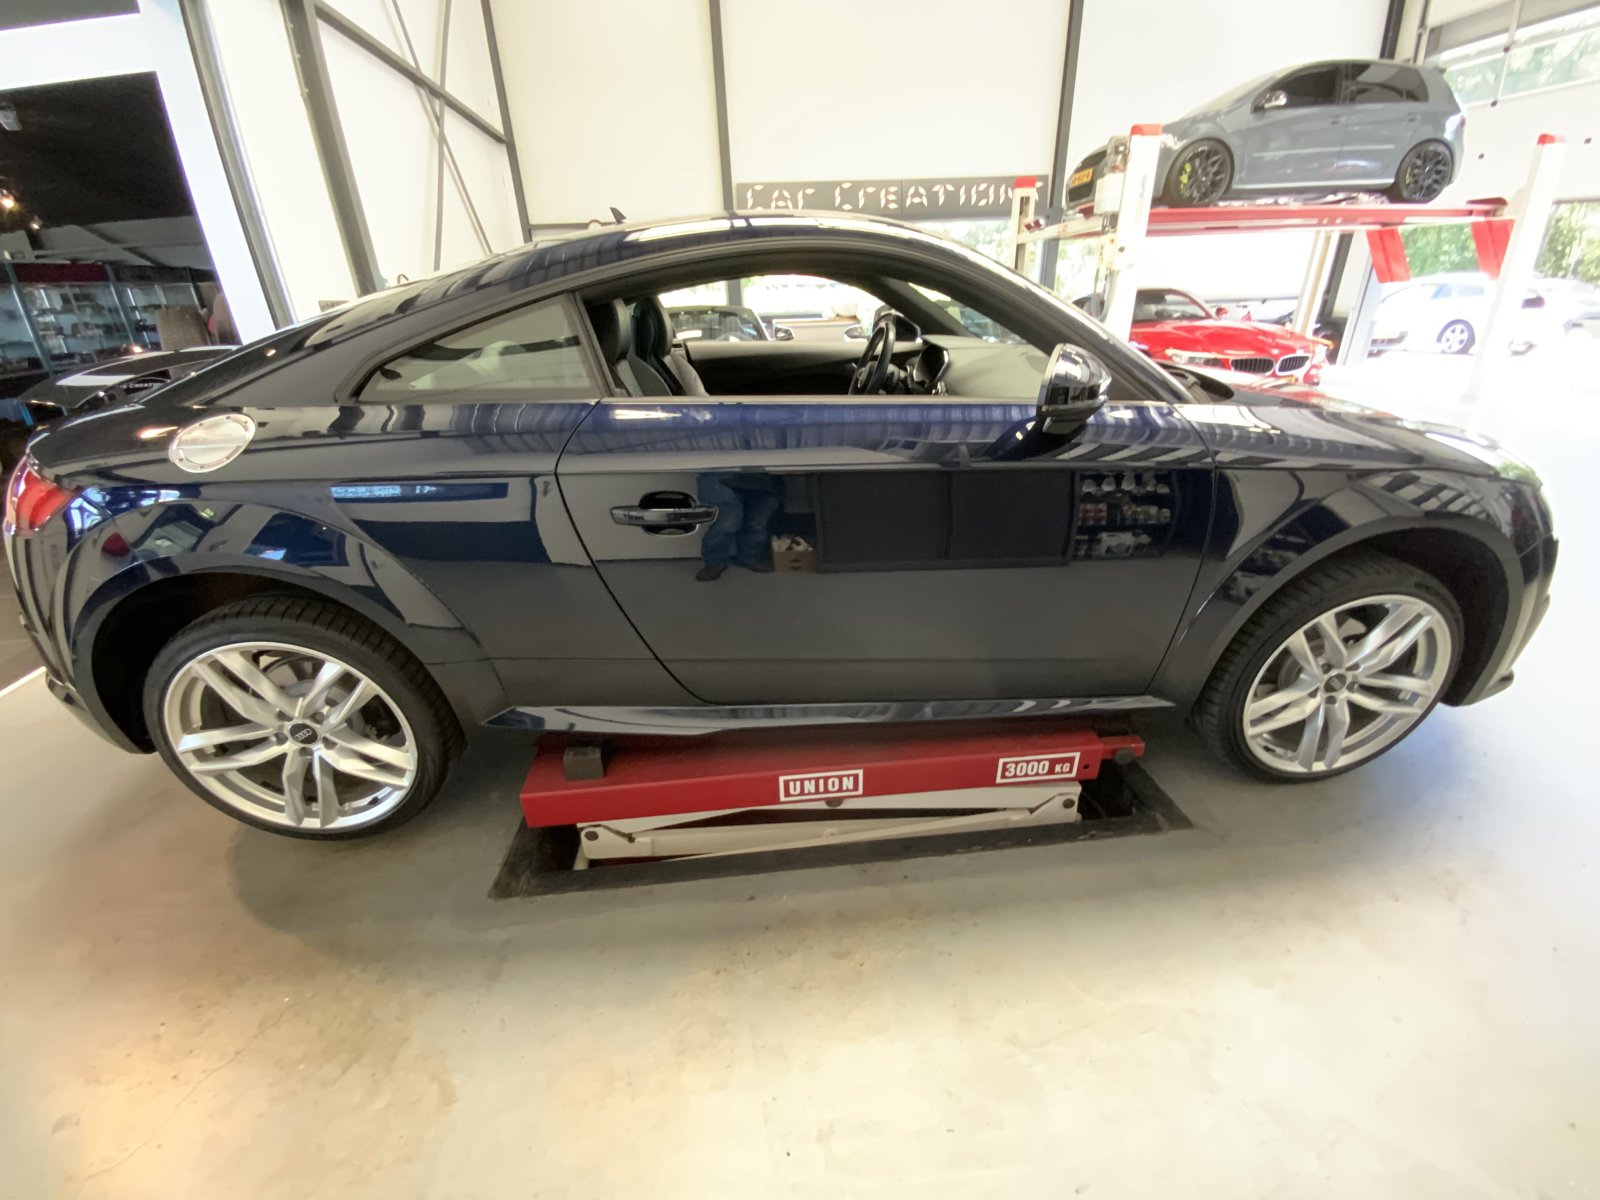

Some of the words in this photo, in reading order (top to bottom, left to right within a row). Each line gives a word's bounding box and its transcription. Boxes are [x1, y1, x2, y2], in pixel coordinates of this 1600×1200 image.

[1004, 760, 1050, 777] 3000
[1054, 762, 1071, 774] KG
[789, 775, 854, 796] UNION
